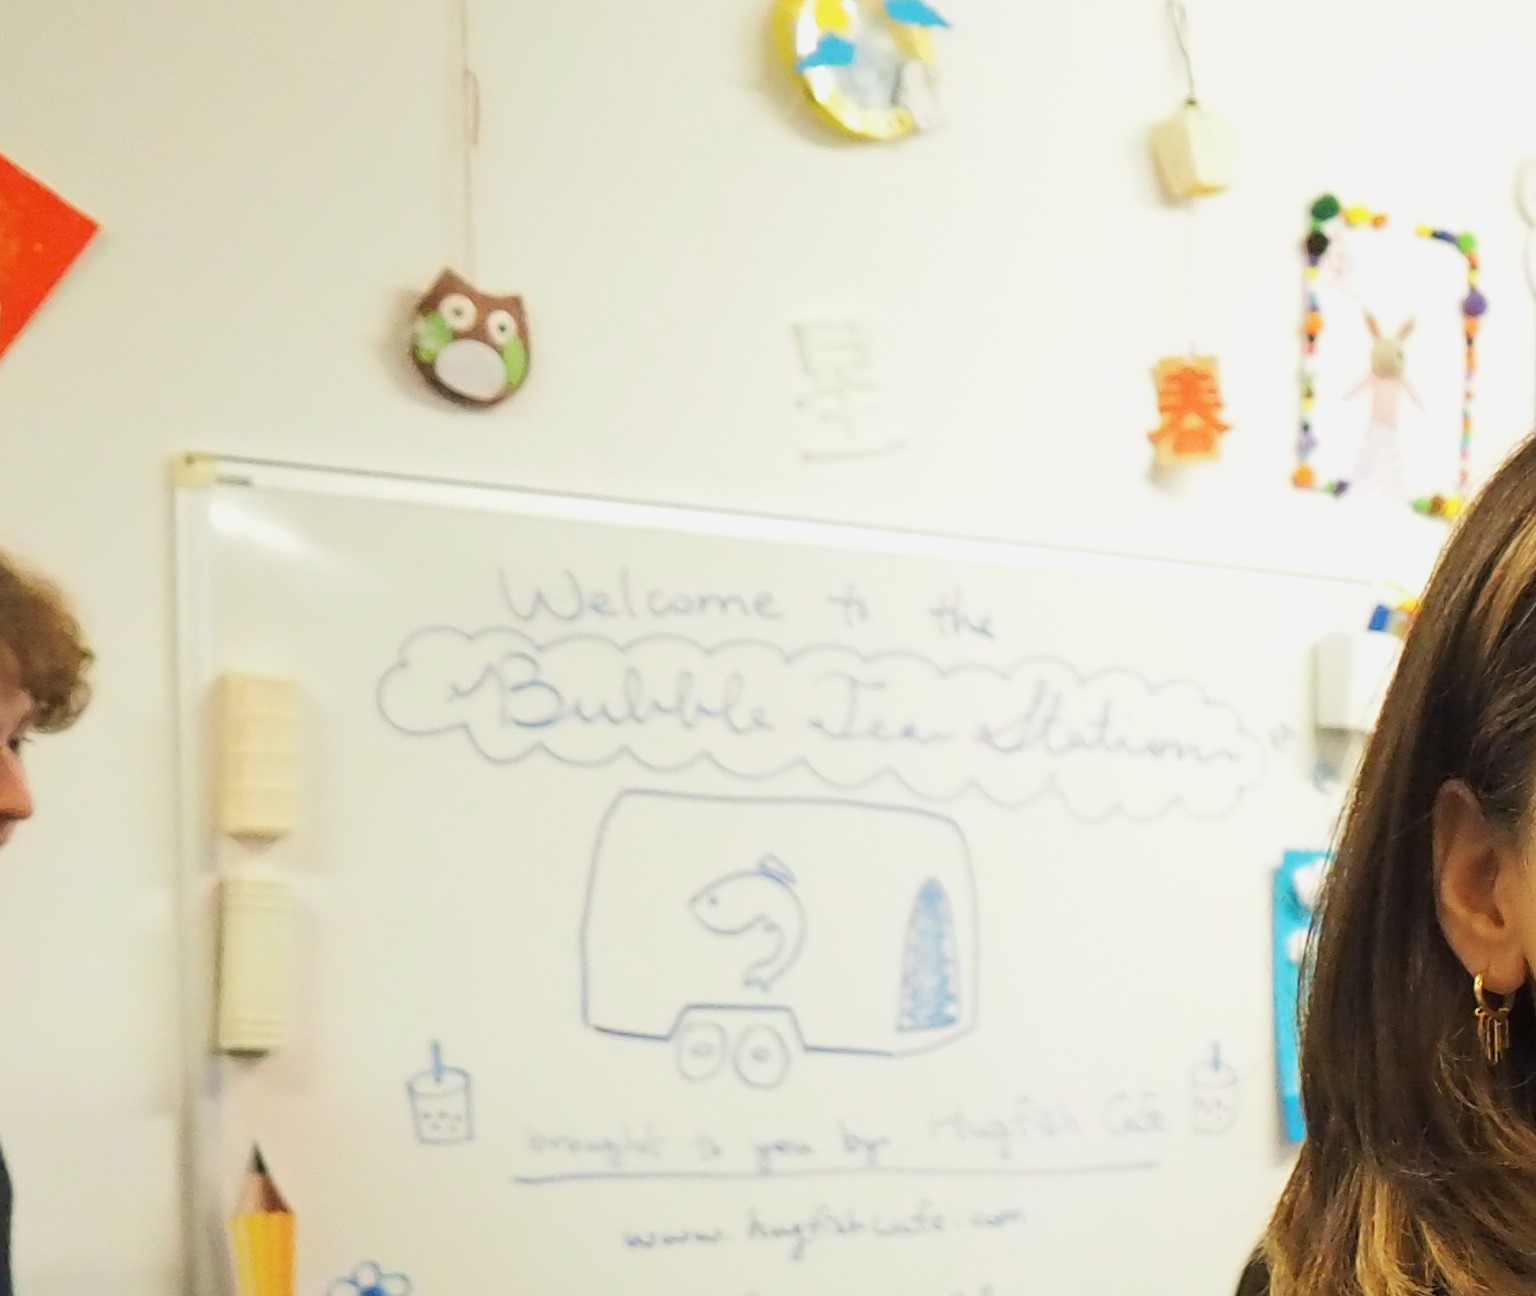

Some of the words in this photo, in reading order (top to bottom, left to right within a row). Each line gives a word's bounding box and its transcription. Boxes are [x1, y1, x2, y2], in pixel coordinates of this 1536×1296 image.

[498, 565, 785, 622] Welcome
[826, 580, 870, 627] to
[928, 584, 997, 641] the
[444, 651, 776, 729] Bubble
[806, 669, 953, 745] Tea
[975, 677, 1242, 767] Station
[753, 1136, 816, 1177] you
